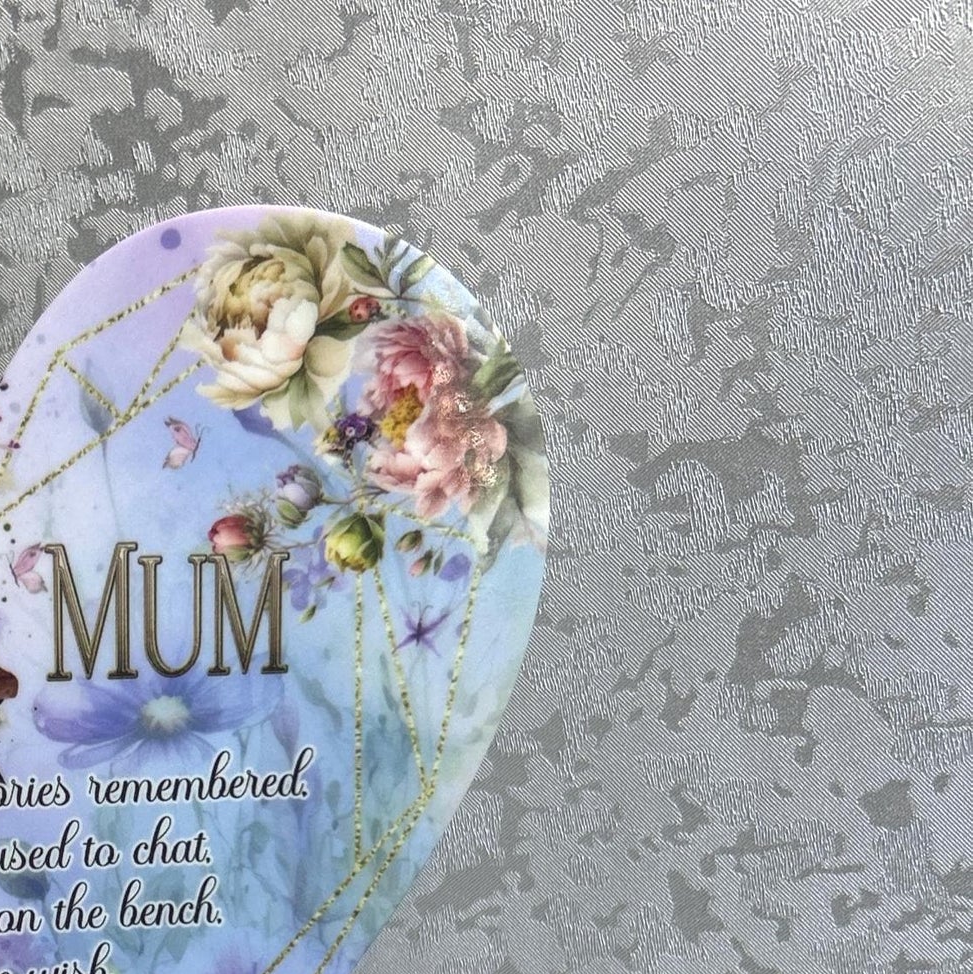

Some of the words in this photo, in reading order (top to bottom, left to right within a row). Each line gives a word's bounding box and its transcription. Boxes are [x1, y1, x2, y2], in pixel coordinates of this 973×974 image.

[44, 541, 289, 682] MUM
[83, 838, 120, 868] to
[54, 881, 108, 931] the
